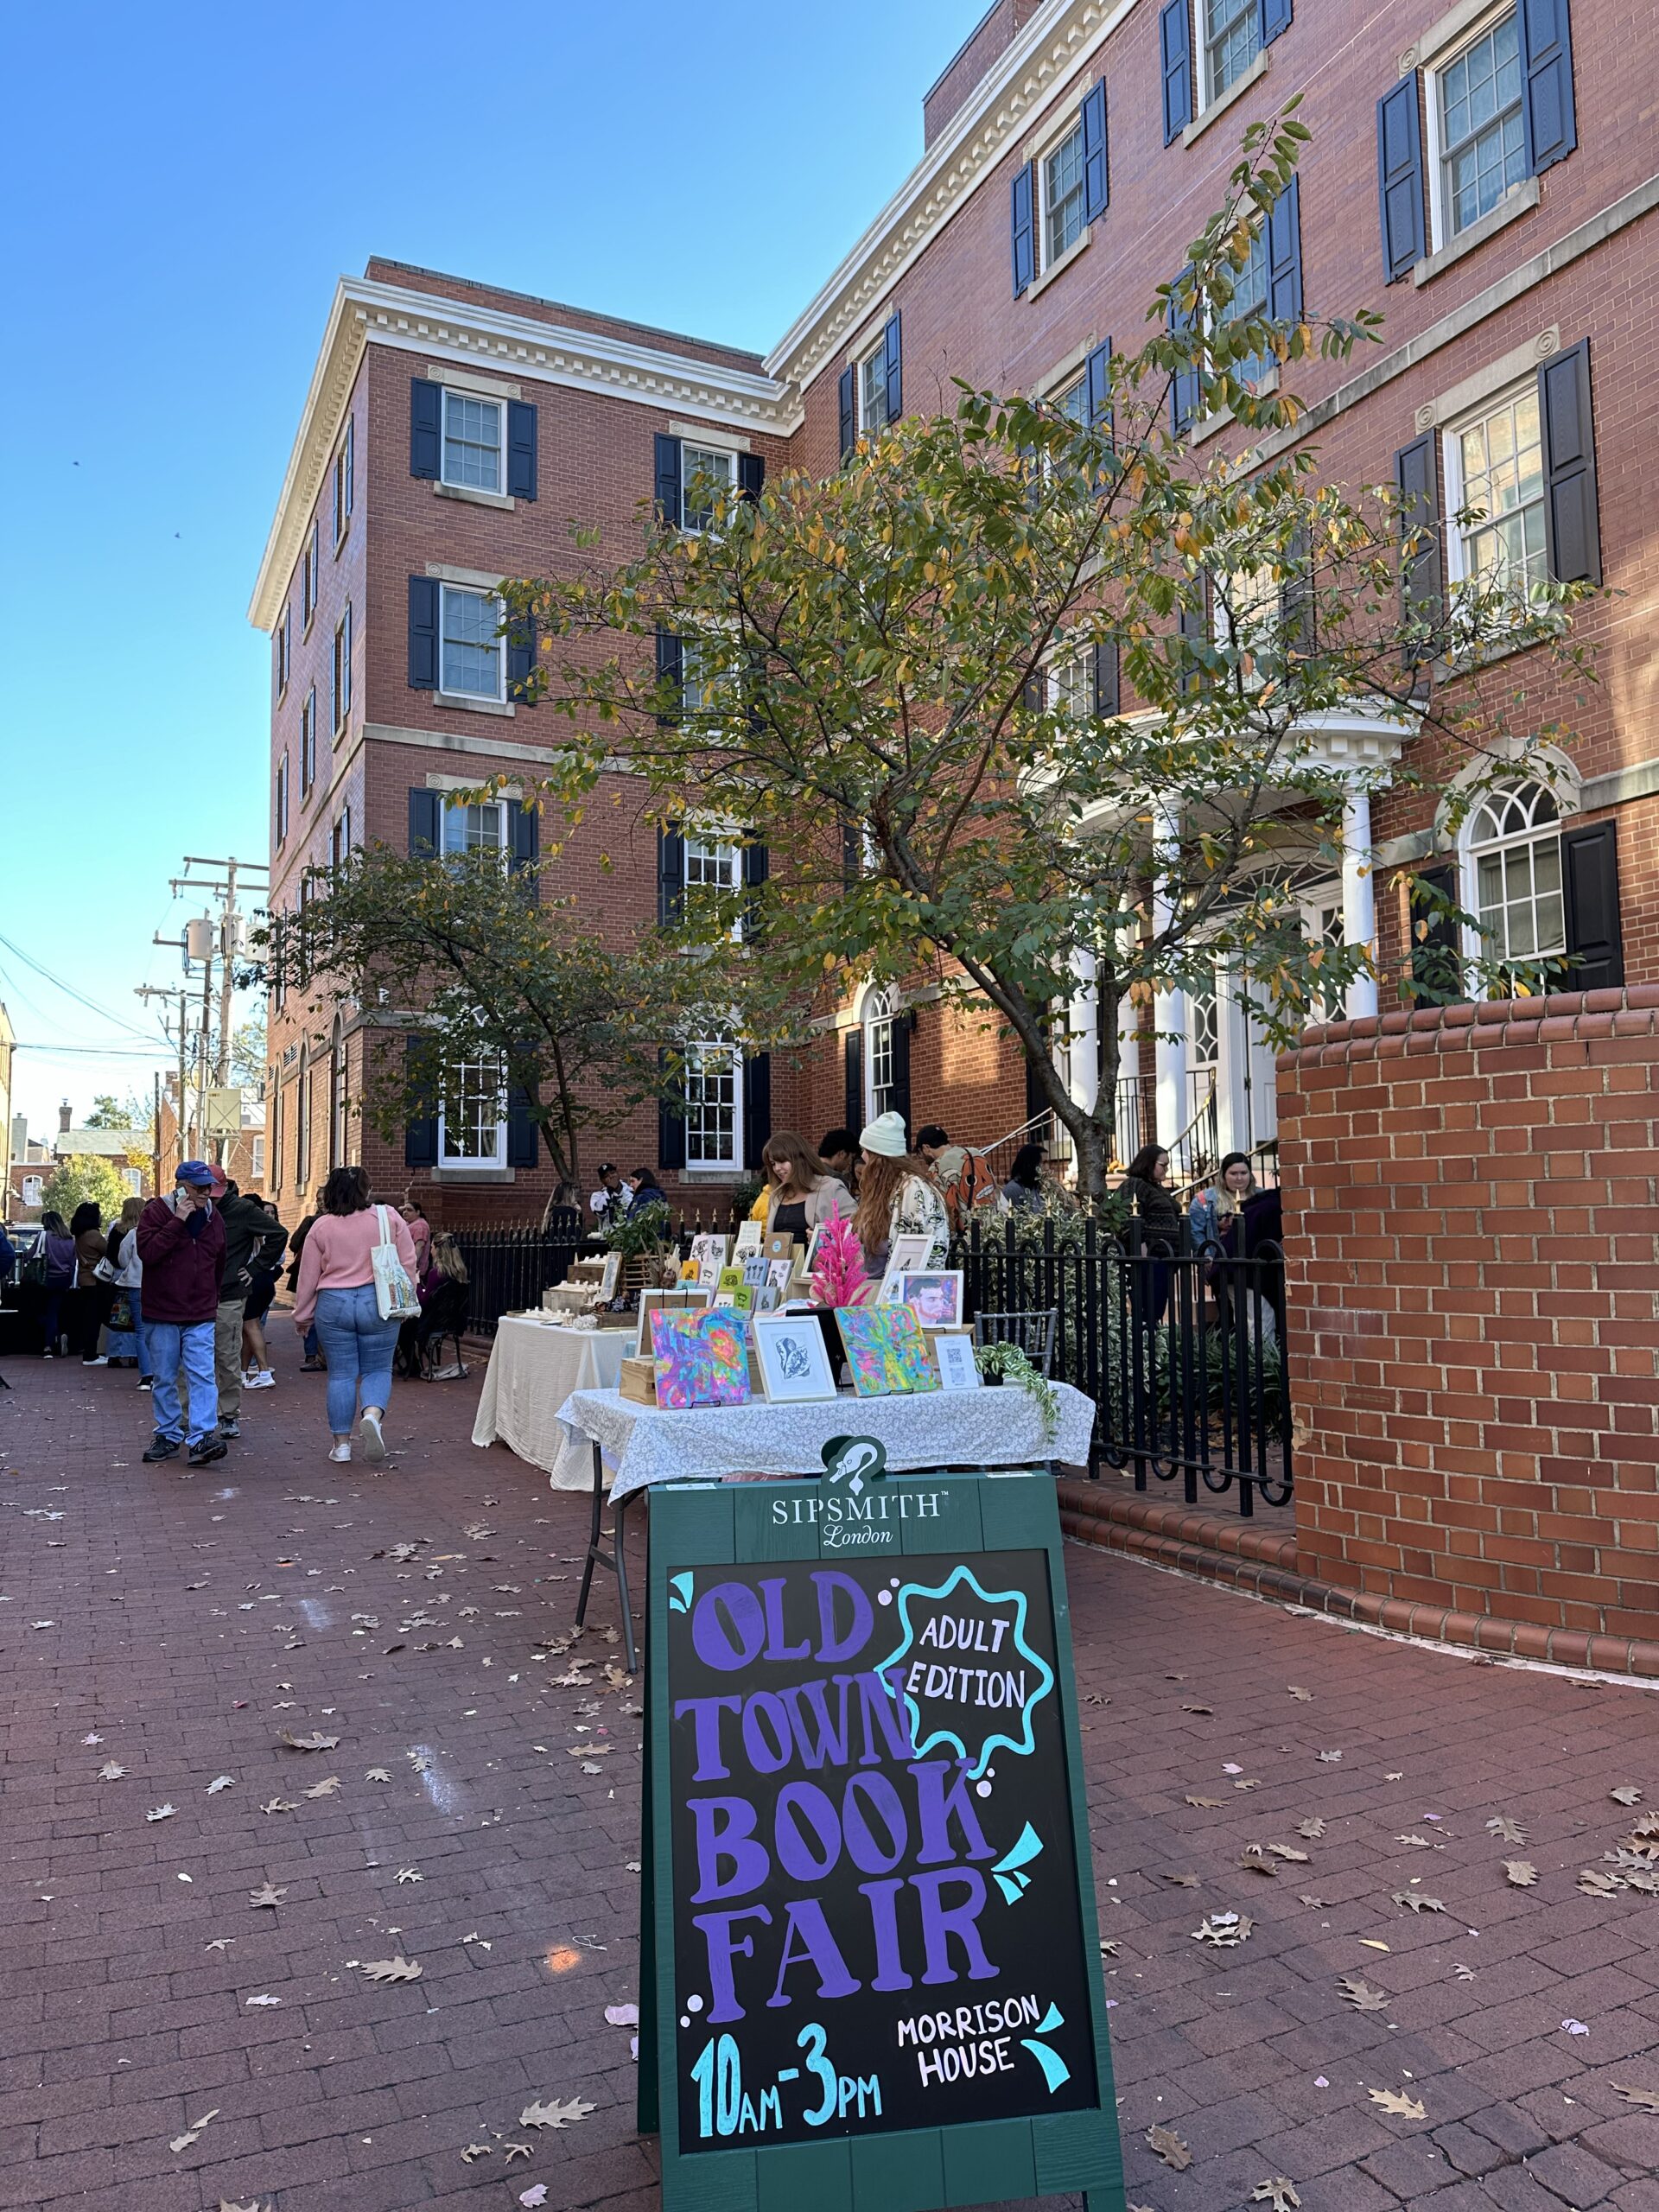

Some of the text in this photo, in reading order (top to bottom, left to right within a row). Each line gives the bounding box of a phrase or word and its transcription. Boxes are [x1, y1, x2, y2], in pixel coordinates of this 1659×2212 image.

[823, 1524, 893, 1548] London
[692, 1571, 874, 1671] OLD
[918, 1614, 1010, 1654] ADULT
[906, 1661, 1026, 1708] EDITION
[675, 1668, 915, 1782] TOWN
[686, 1758, 997, 1904] BOOK
[692, 1866, 1000, 2023] FAIR
[897, 1993, 1040, 2047] MORRISON
[917, 2036, 1015, 2088] HOUSE
